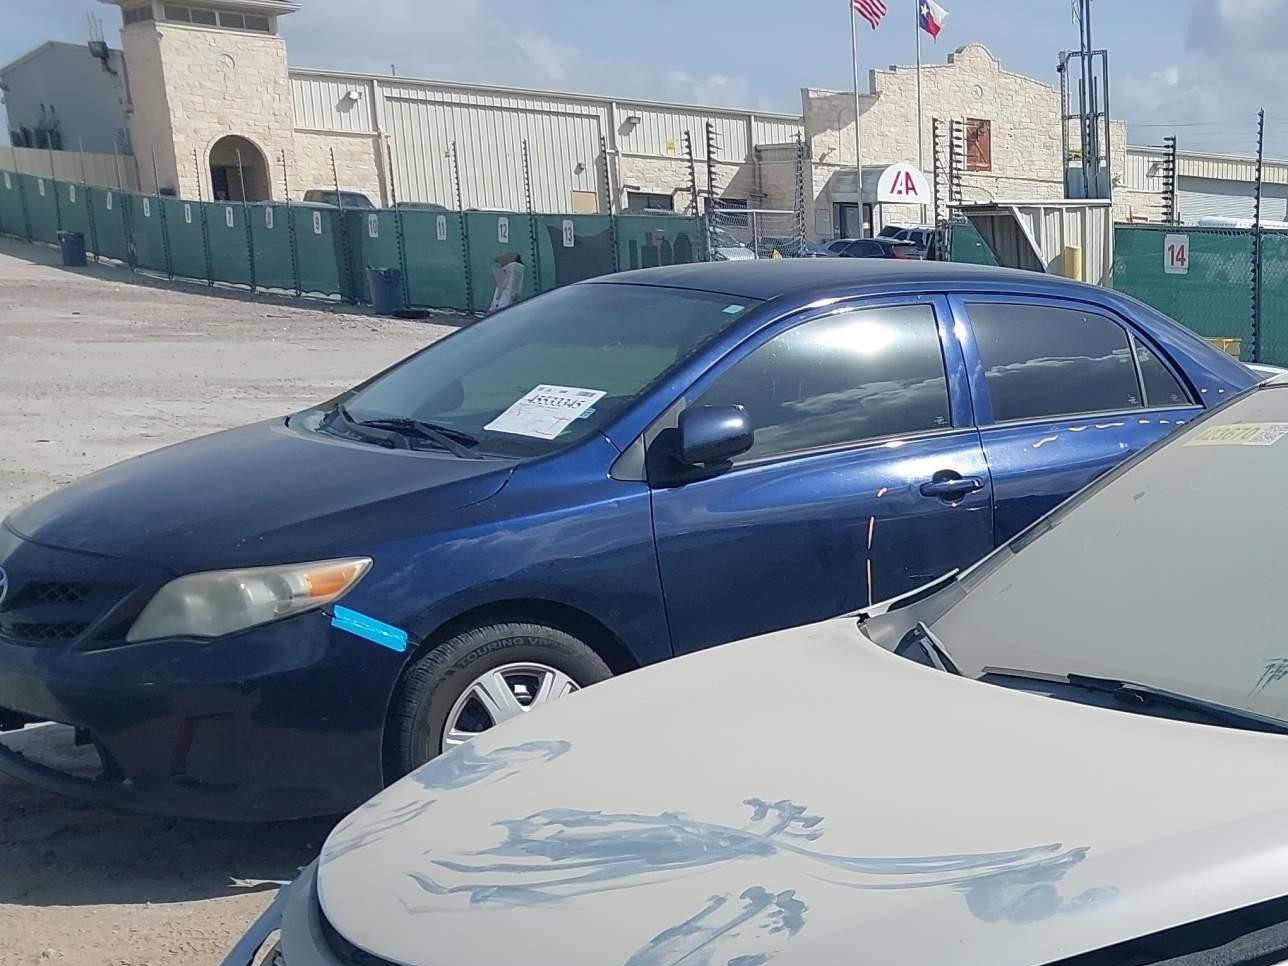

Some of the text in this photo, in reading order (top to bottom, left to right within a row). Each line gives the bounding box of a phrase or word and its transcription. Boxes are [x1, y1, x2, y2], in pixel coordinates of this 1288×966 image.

[500, 223, 508, 239] 12
[564, 226, 573, 242] 13
[1168, 244, 1186, 266] 14
[460, 638, 524, 667] TOURING
